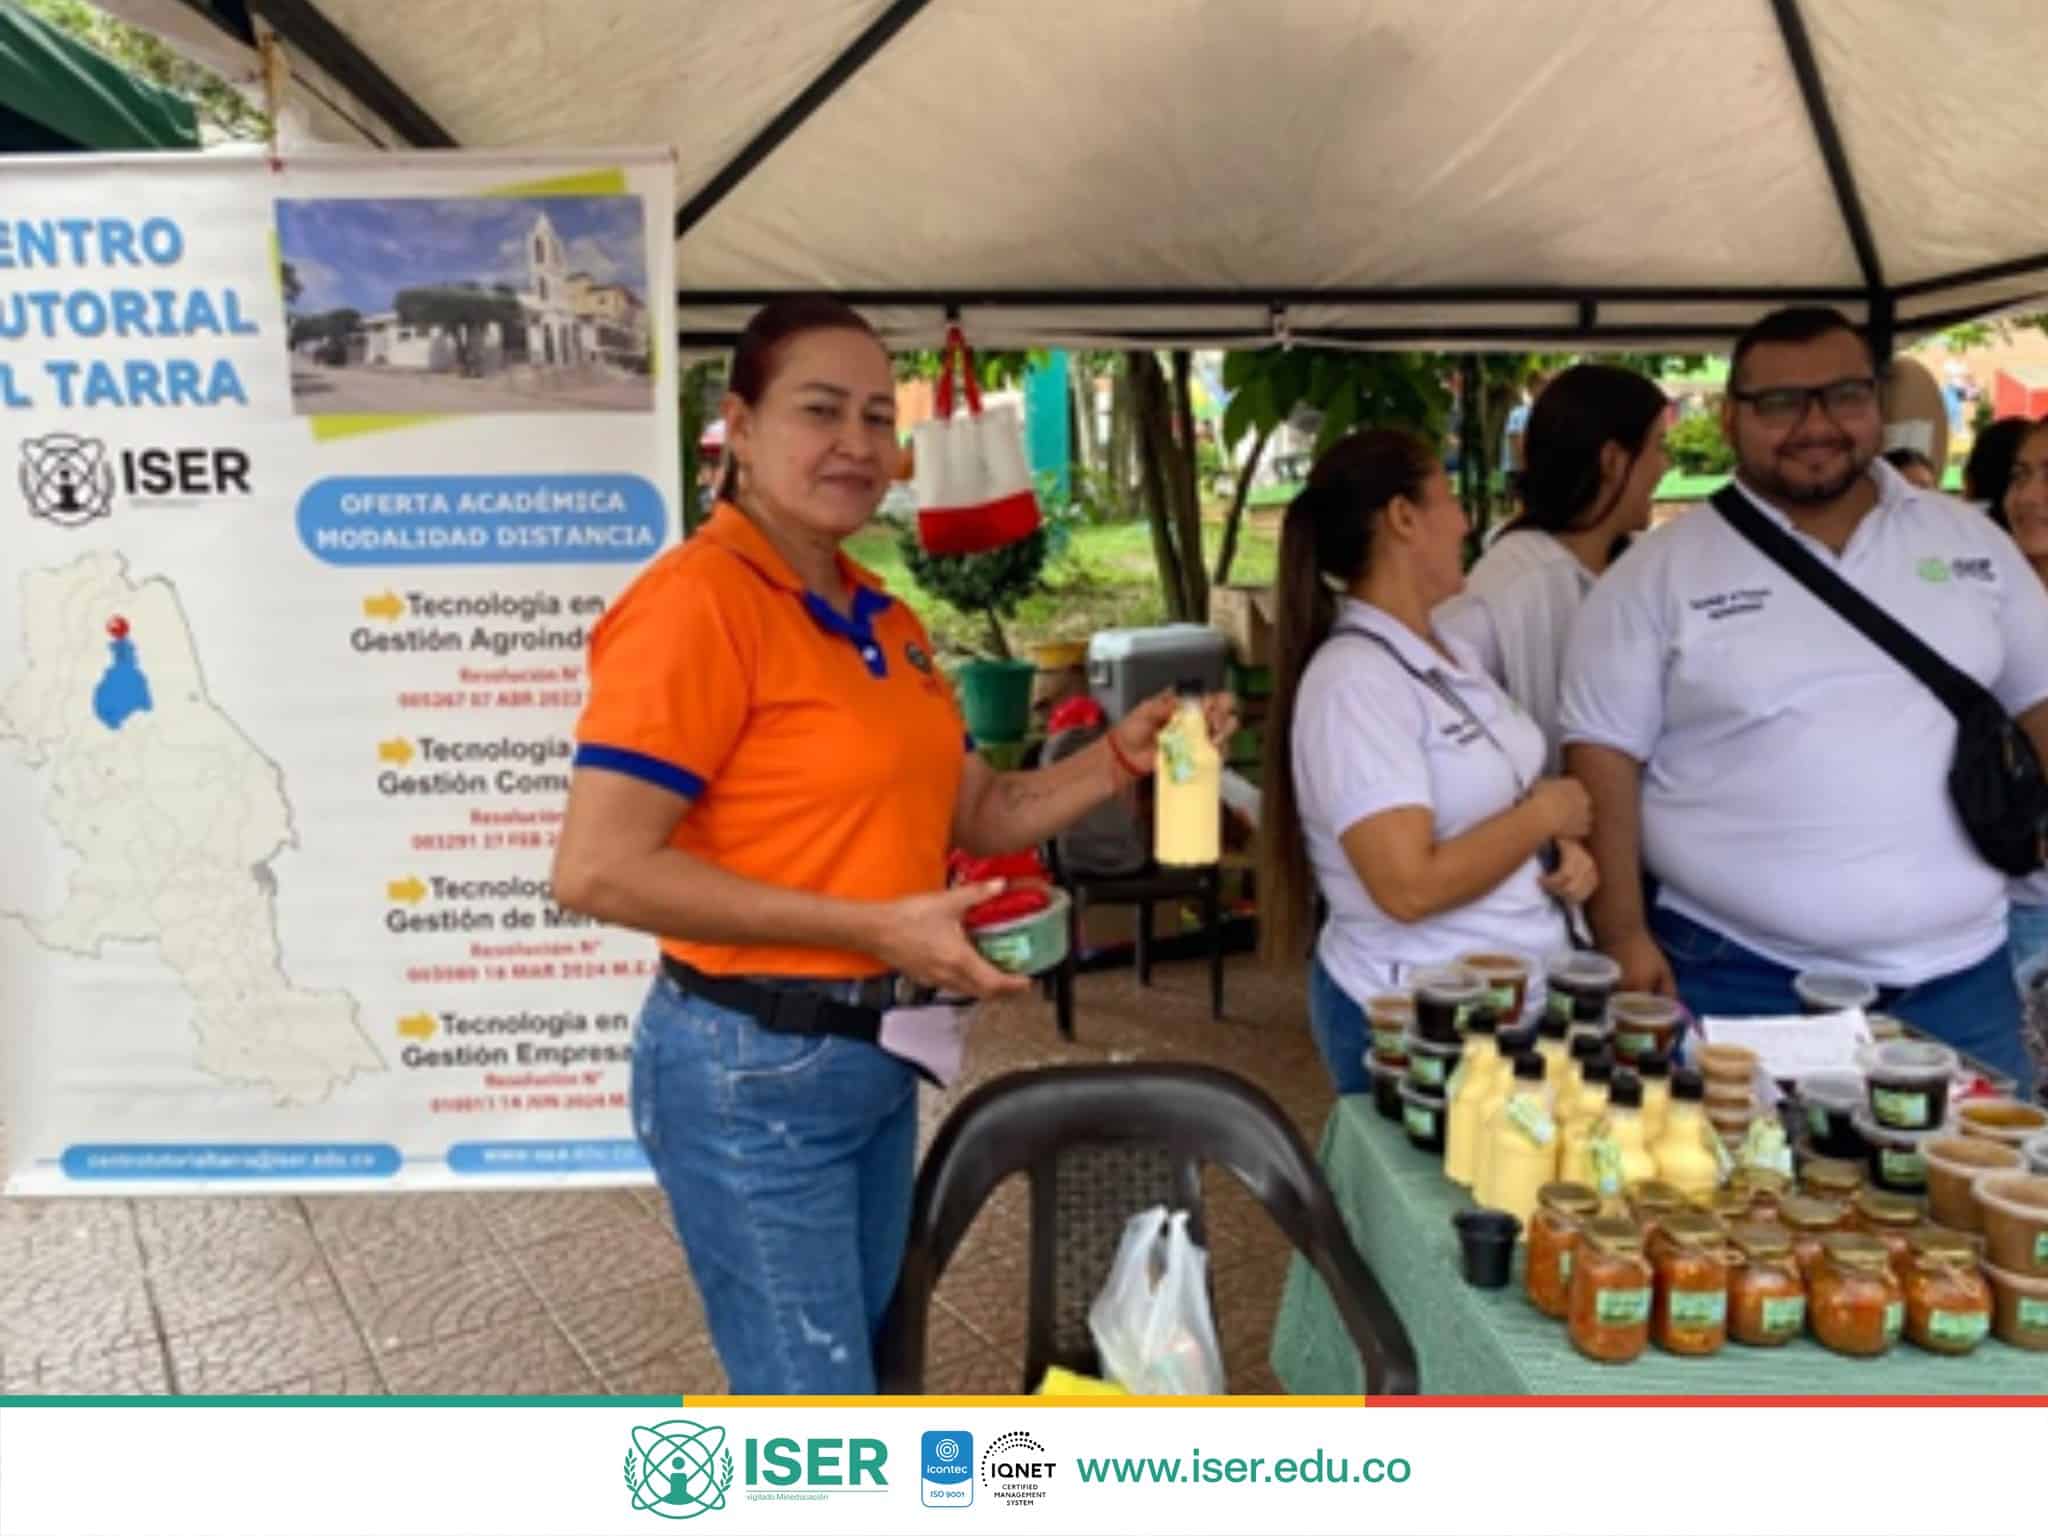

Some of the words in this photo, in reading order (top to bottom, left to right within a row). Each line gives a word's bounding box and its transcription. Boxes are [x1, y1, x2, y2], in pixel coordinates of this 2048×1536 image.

[45, 358, 249, 407] TARRA
[120, 448, 254, 495] ISER
[340, 493, 450, 515] OFERTA
[456, 486, 626, 513] ACADÉMICA
[316, 528, 489, 551] MODALIDAD
[496, 524, 656, 548] DISTANCIA
[350, 626, 463, 652] Gestión
[378, 769, 486, 796] Gestión
[386, 907, 494, 933] Gestión
[501, 907, 536, 928] de
[595, 1013, 629, 1031] en
[402, 1043, 509, 1067] Gestión
